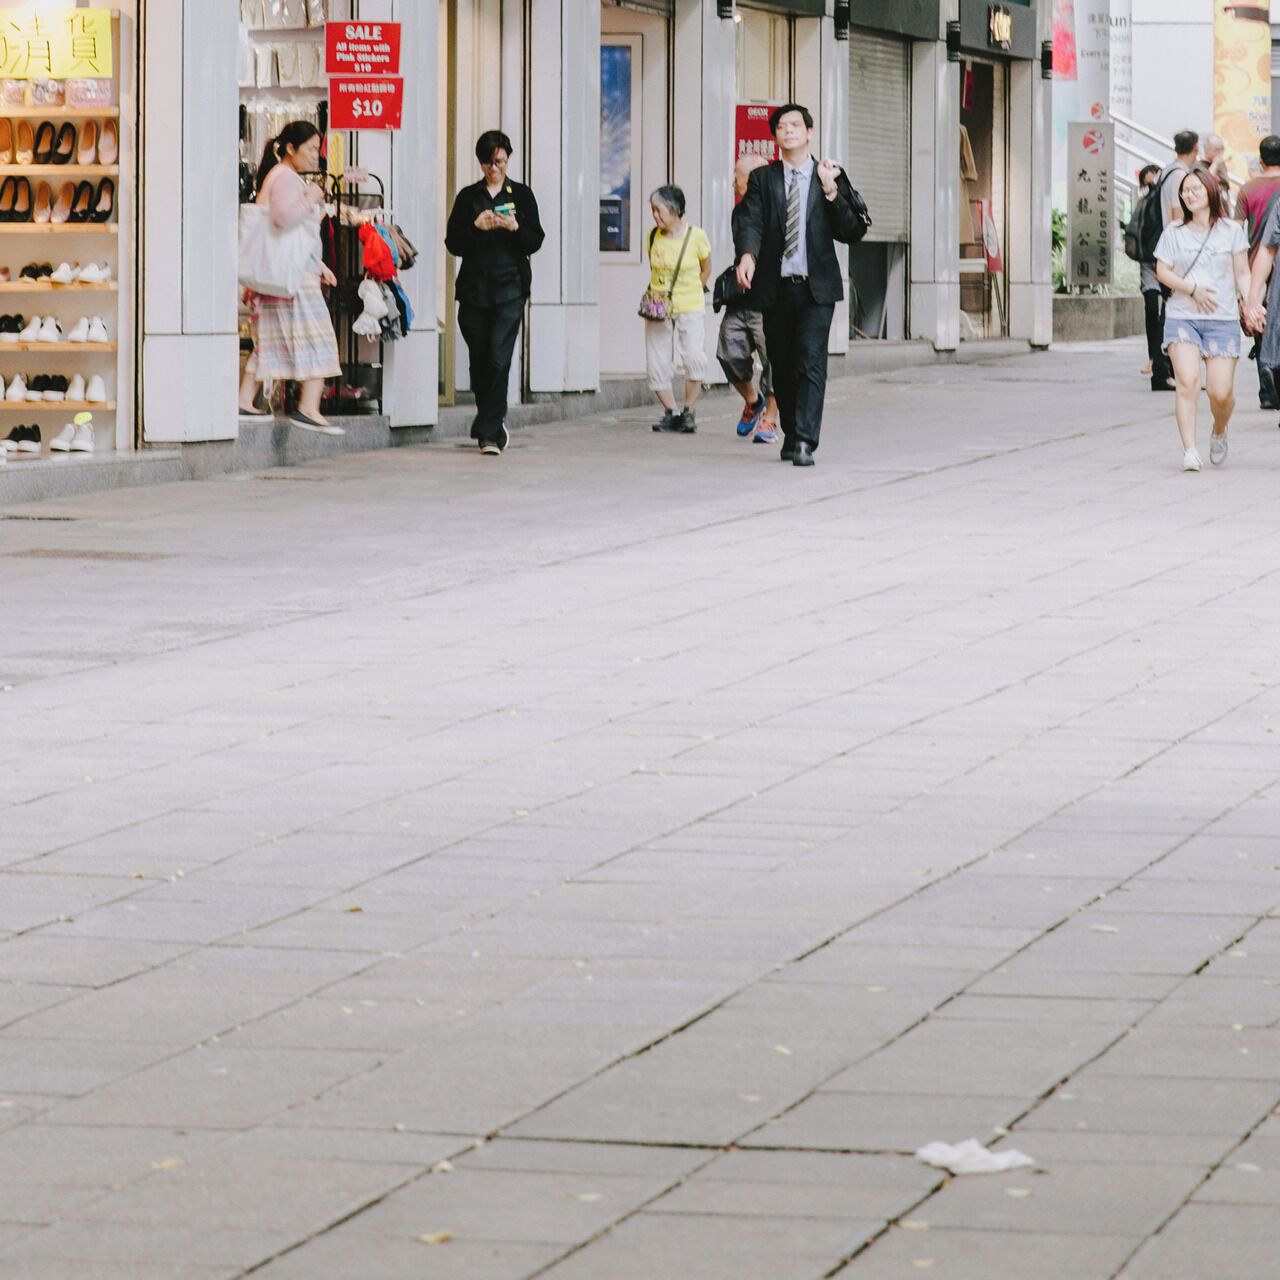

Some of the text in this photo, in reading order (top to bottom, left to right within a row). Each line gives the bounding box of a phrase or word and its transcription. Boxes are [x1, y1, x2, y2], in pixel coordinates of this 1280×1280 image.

[345, 25, 383, 40] SALE
[336, 41, 391, 53] All items with
[336, 52, 390, 63] Pink Stickers
[352, 97, 383, 119] $10
[1076, 168, 1093, 278] 九龍公園
[1097, 168, 1108, 278] Kowloon Park
